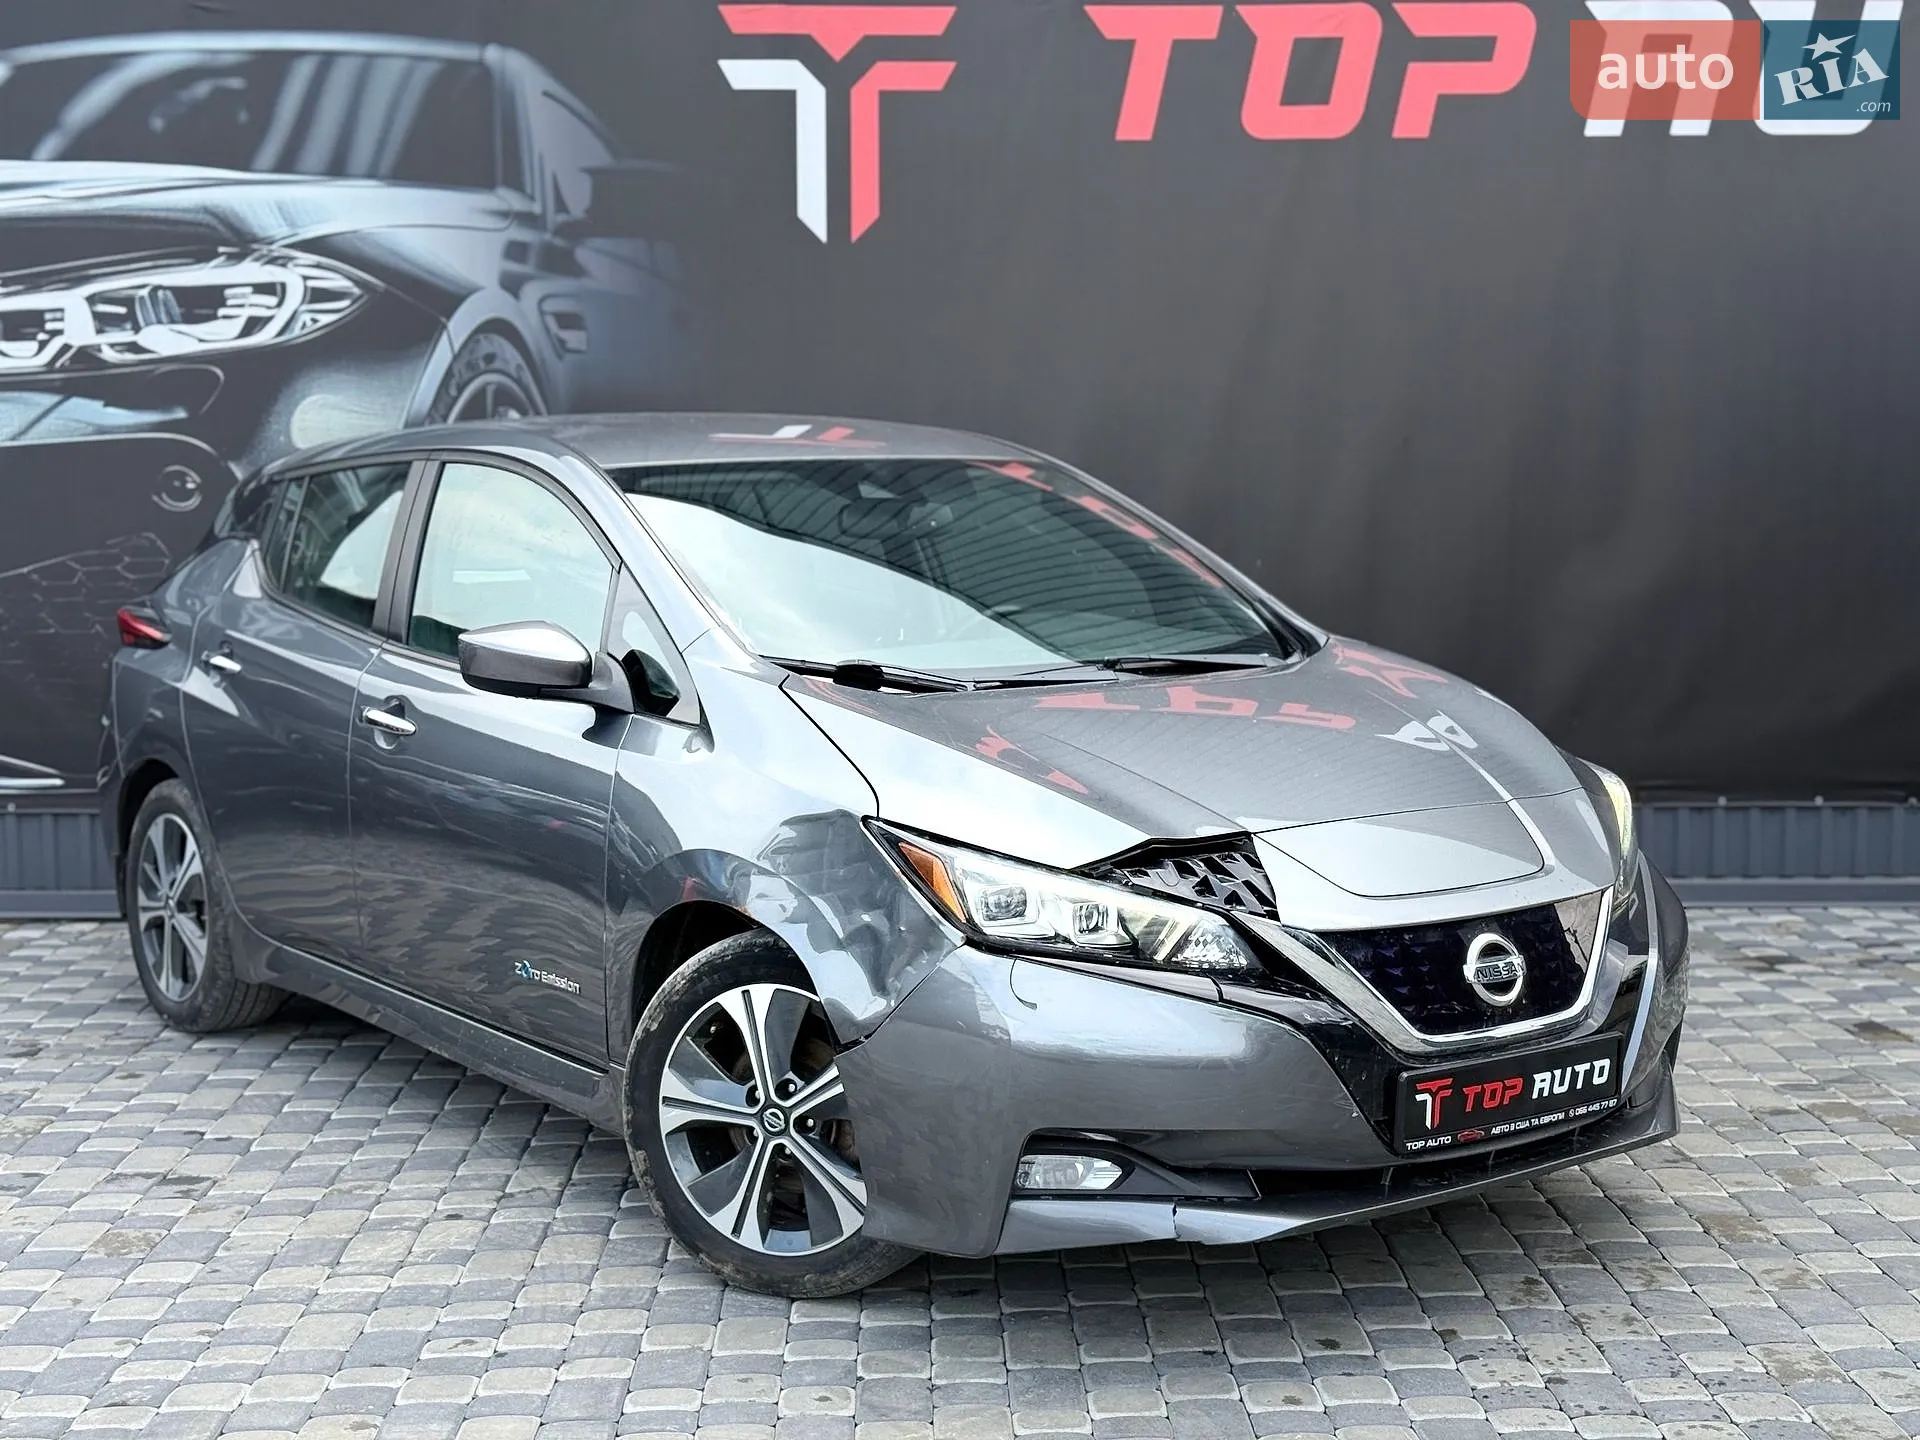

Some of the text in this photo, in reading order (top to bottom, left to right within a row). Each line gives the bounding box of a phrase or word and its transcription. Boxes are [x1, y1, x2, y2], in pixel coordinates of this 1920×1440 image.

[1084, 1, 1538, 141] TOP
[1476, 960, 1525, 979] NISSAN
[541, 971, 580, 994] Emission
[1463, 1058, 1611, 1112] TOP AUTO
[1406, 1136, 1452, 1151] TOP AUTO
